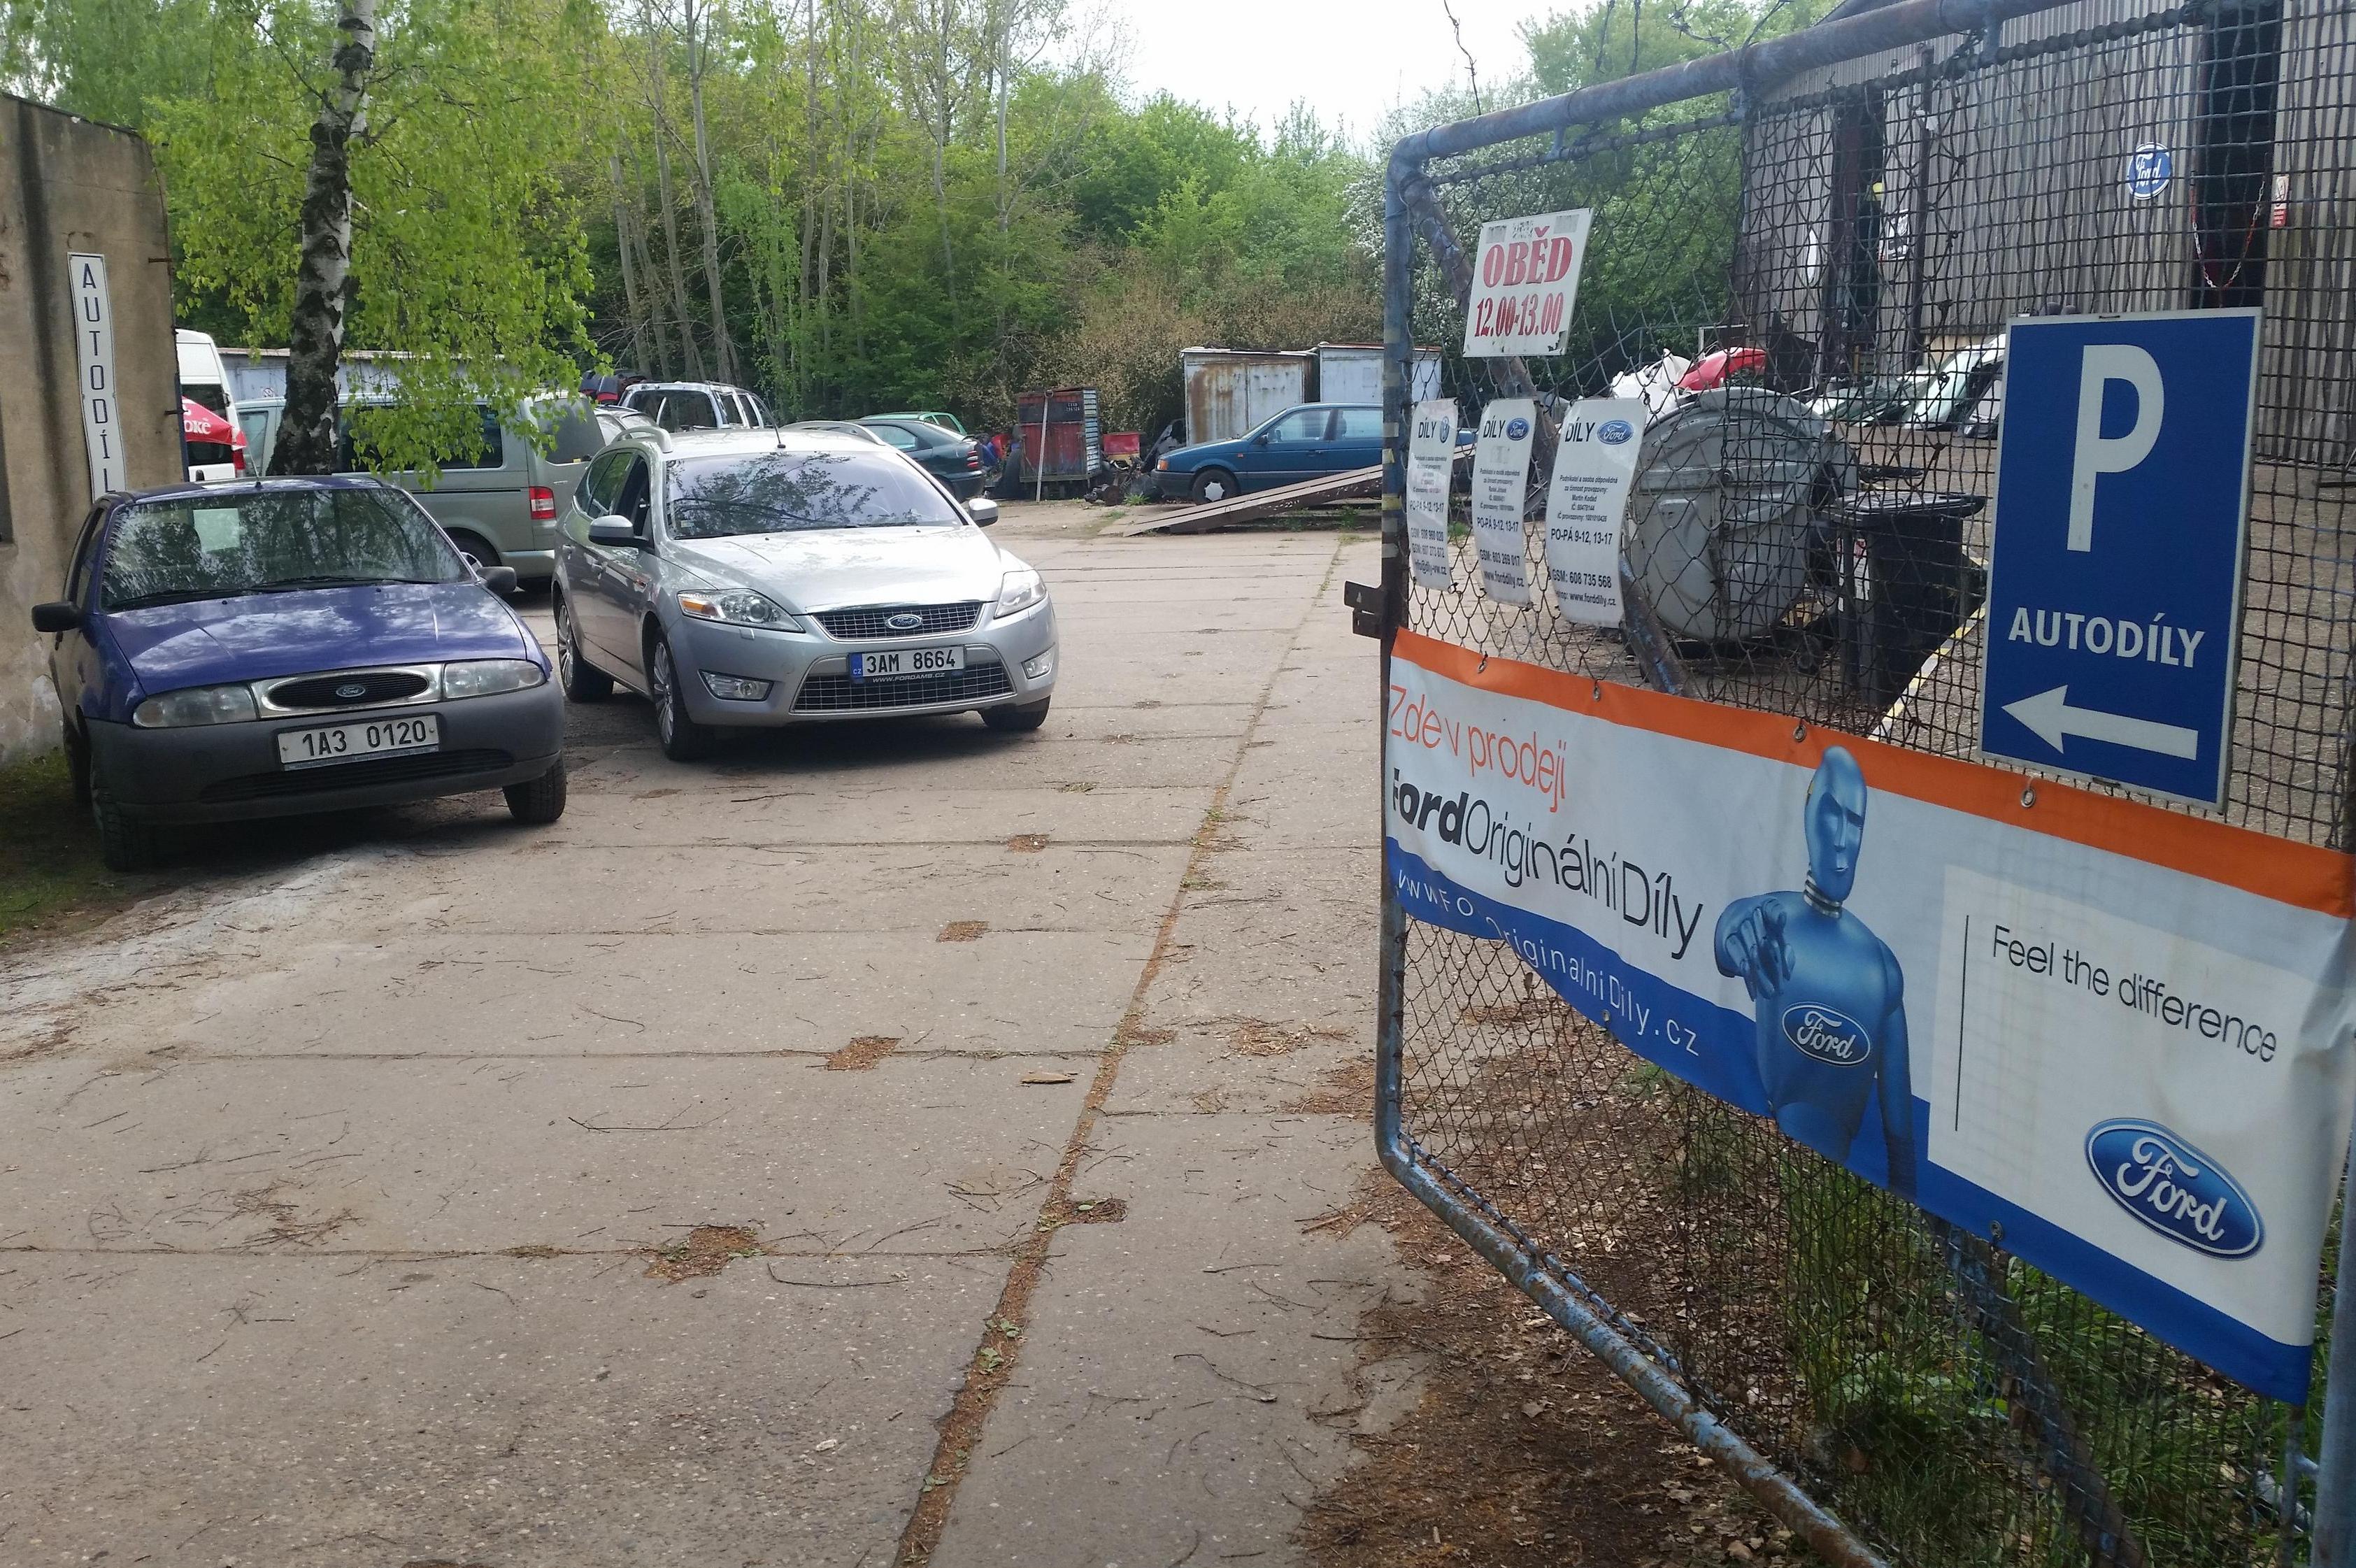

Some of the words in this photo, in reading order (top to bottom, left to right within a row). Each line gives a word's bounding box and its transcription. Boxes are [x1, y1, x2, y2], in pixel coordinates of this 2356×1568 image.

[1483, 225, 1573, 288] OBĚD
[1474, 292, 1564, 337] 12.00-13.00
[1418, 417, 1437, 439] DÍLY
[1483, 415, 1506, 439] DÍLY
[1564, 416, 1596, 443] DÍLY
[2066, 344, 2165, 552] P
[1477, 515, 1492, 529] PO-PÁ
[1505, 520, 1519, 532] 13-17
[1550, 526, 1573, 541] PO-PÁ
[1574, 530, 1592, 546] 9-12,
[1594, 532, 1613, 545] 13-17
[1552, 569, 1568, 583] GSM:
[1569, 571, 1582, 585] 608
[1583, 573, 1597, 587] 735
[1598, 575, 1612, 588] 568
[2008, 606, 2206, 669] AUTODÍLY
[866, 653, 900, 673] 3AM
[913, 649, 956, 670] 8664
[302, 730, 348, 757] 1A3
[366, 720, 427, 748] 0120
[1390, 684, 1443, 749] Zde
[1445, 717, 1461, 757] v
[1468, 725, 1567, 813] prodeji
[1992, 924, 2055, 976] Feel
[2062, 947, 2110, 996] the
[2118, 972, 2277, 1063] difference
[1797, 1010, 1857, 1059] Ford
[2116, 1136, 2227, 1241] Ford
